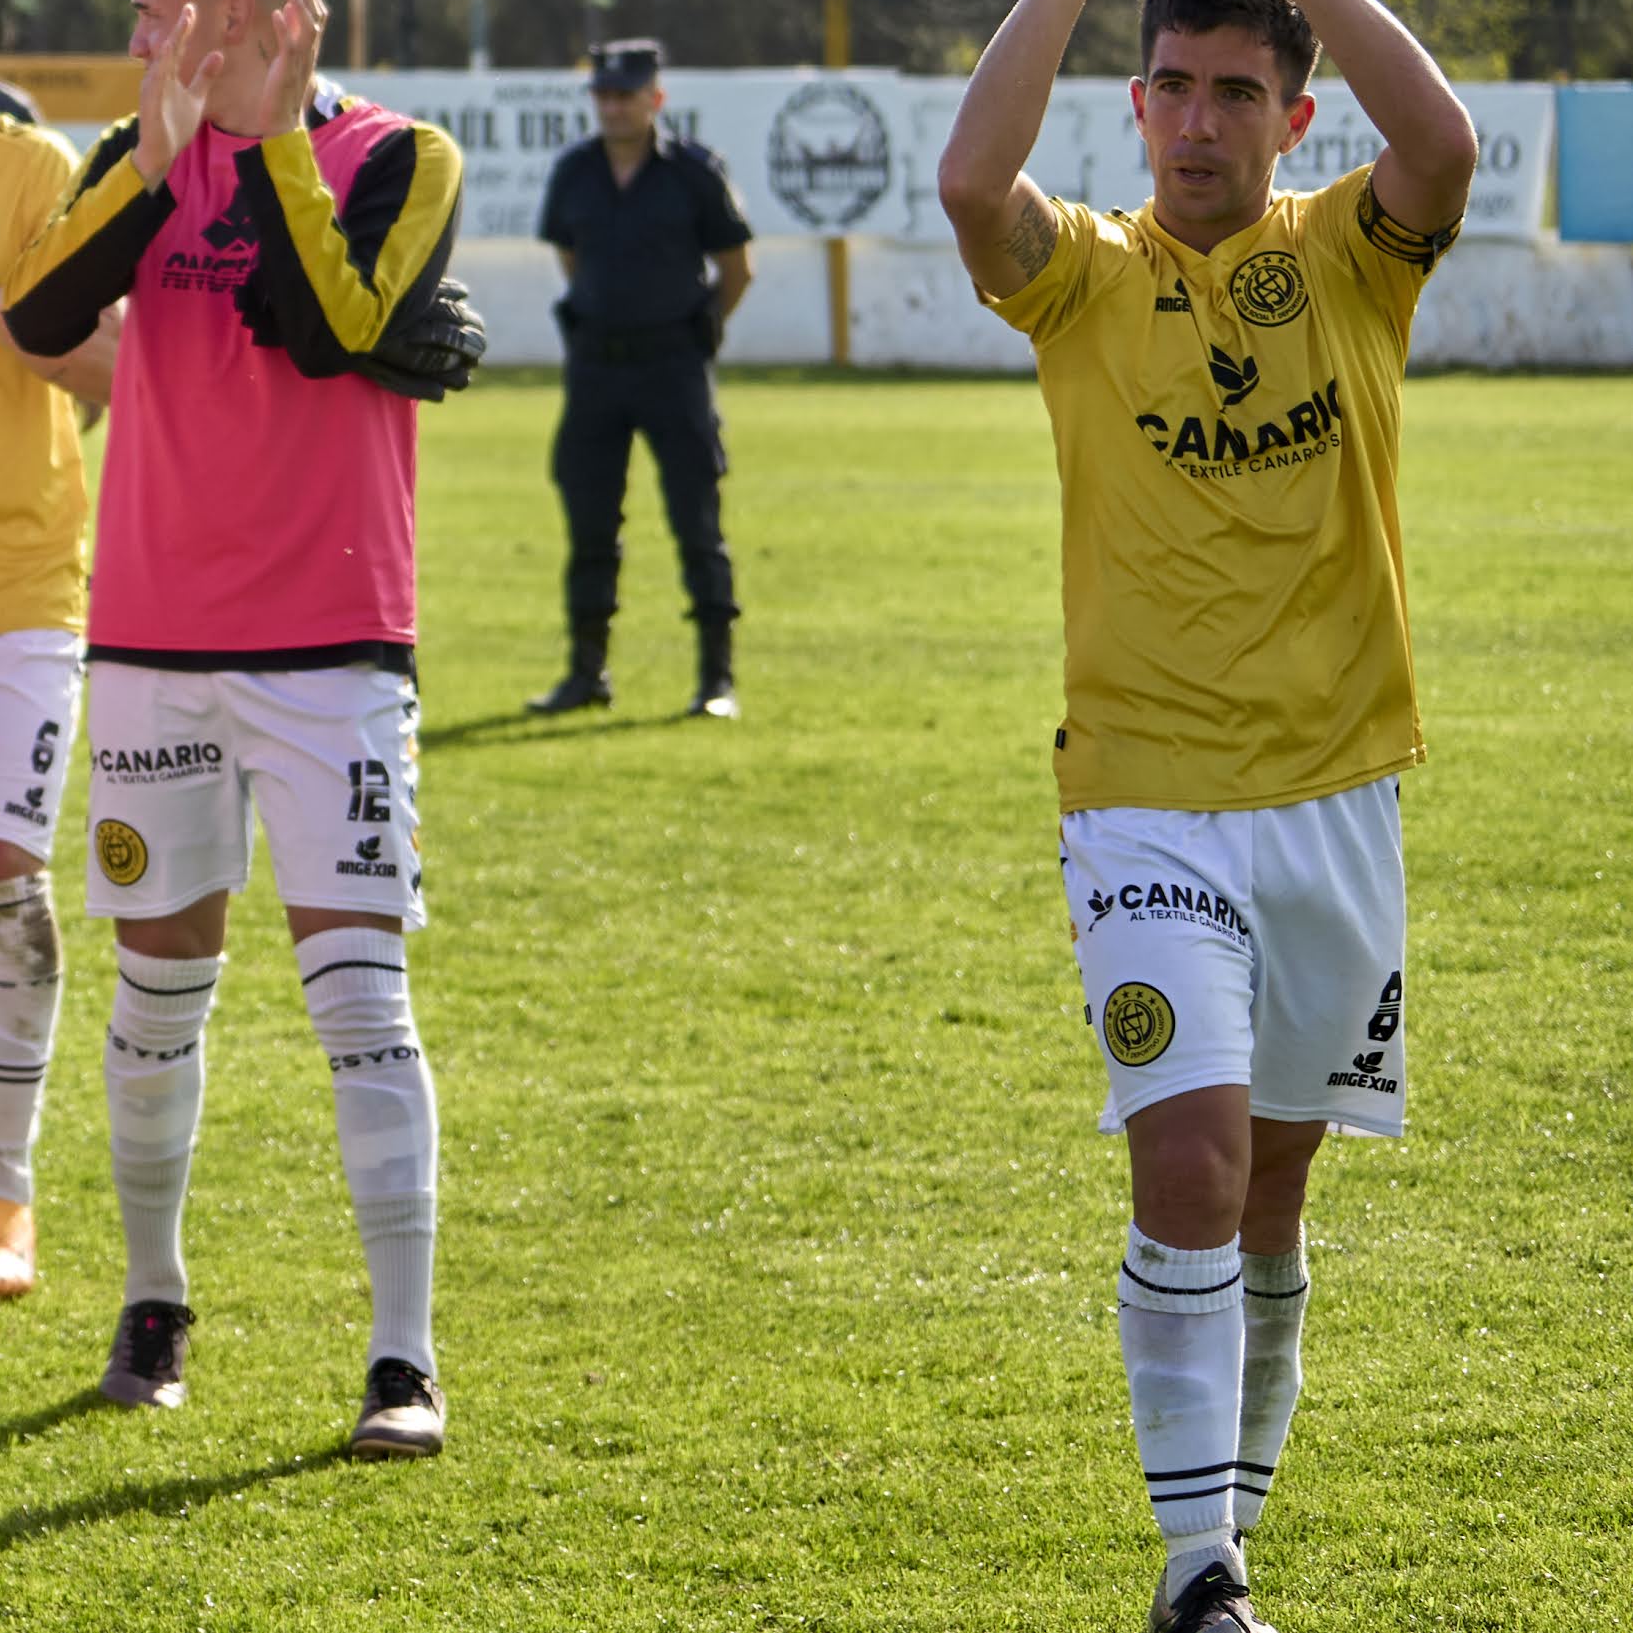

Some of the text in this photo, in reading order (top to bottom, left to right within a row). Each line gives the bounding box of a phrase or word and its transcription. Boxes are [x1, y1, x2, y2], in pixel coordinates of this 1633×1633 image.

[1155, 296, 1192, 312] ANGE
[100, 743, 222, 773] CANARIO
[347, 759, 391, 822] 12
[335, 859, 398, 879] ANGEXIA
[1130, 911, 1146, 922] AL
[1149, 909, 1197, 923] TEXTILE
[1199, 916, 1236, 942] CANARIO
[1327, 1071, 1398, 1094] ANGEXIA
